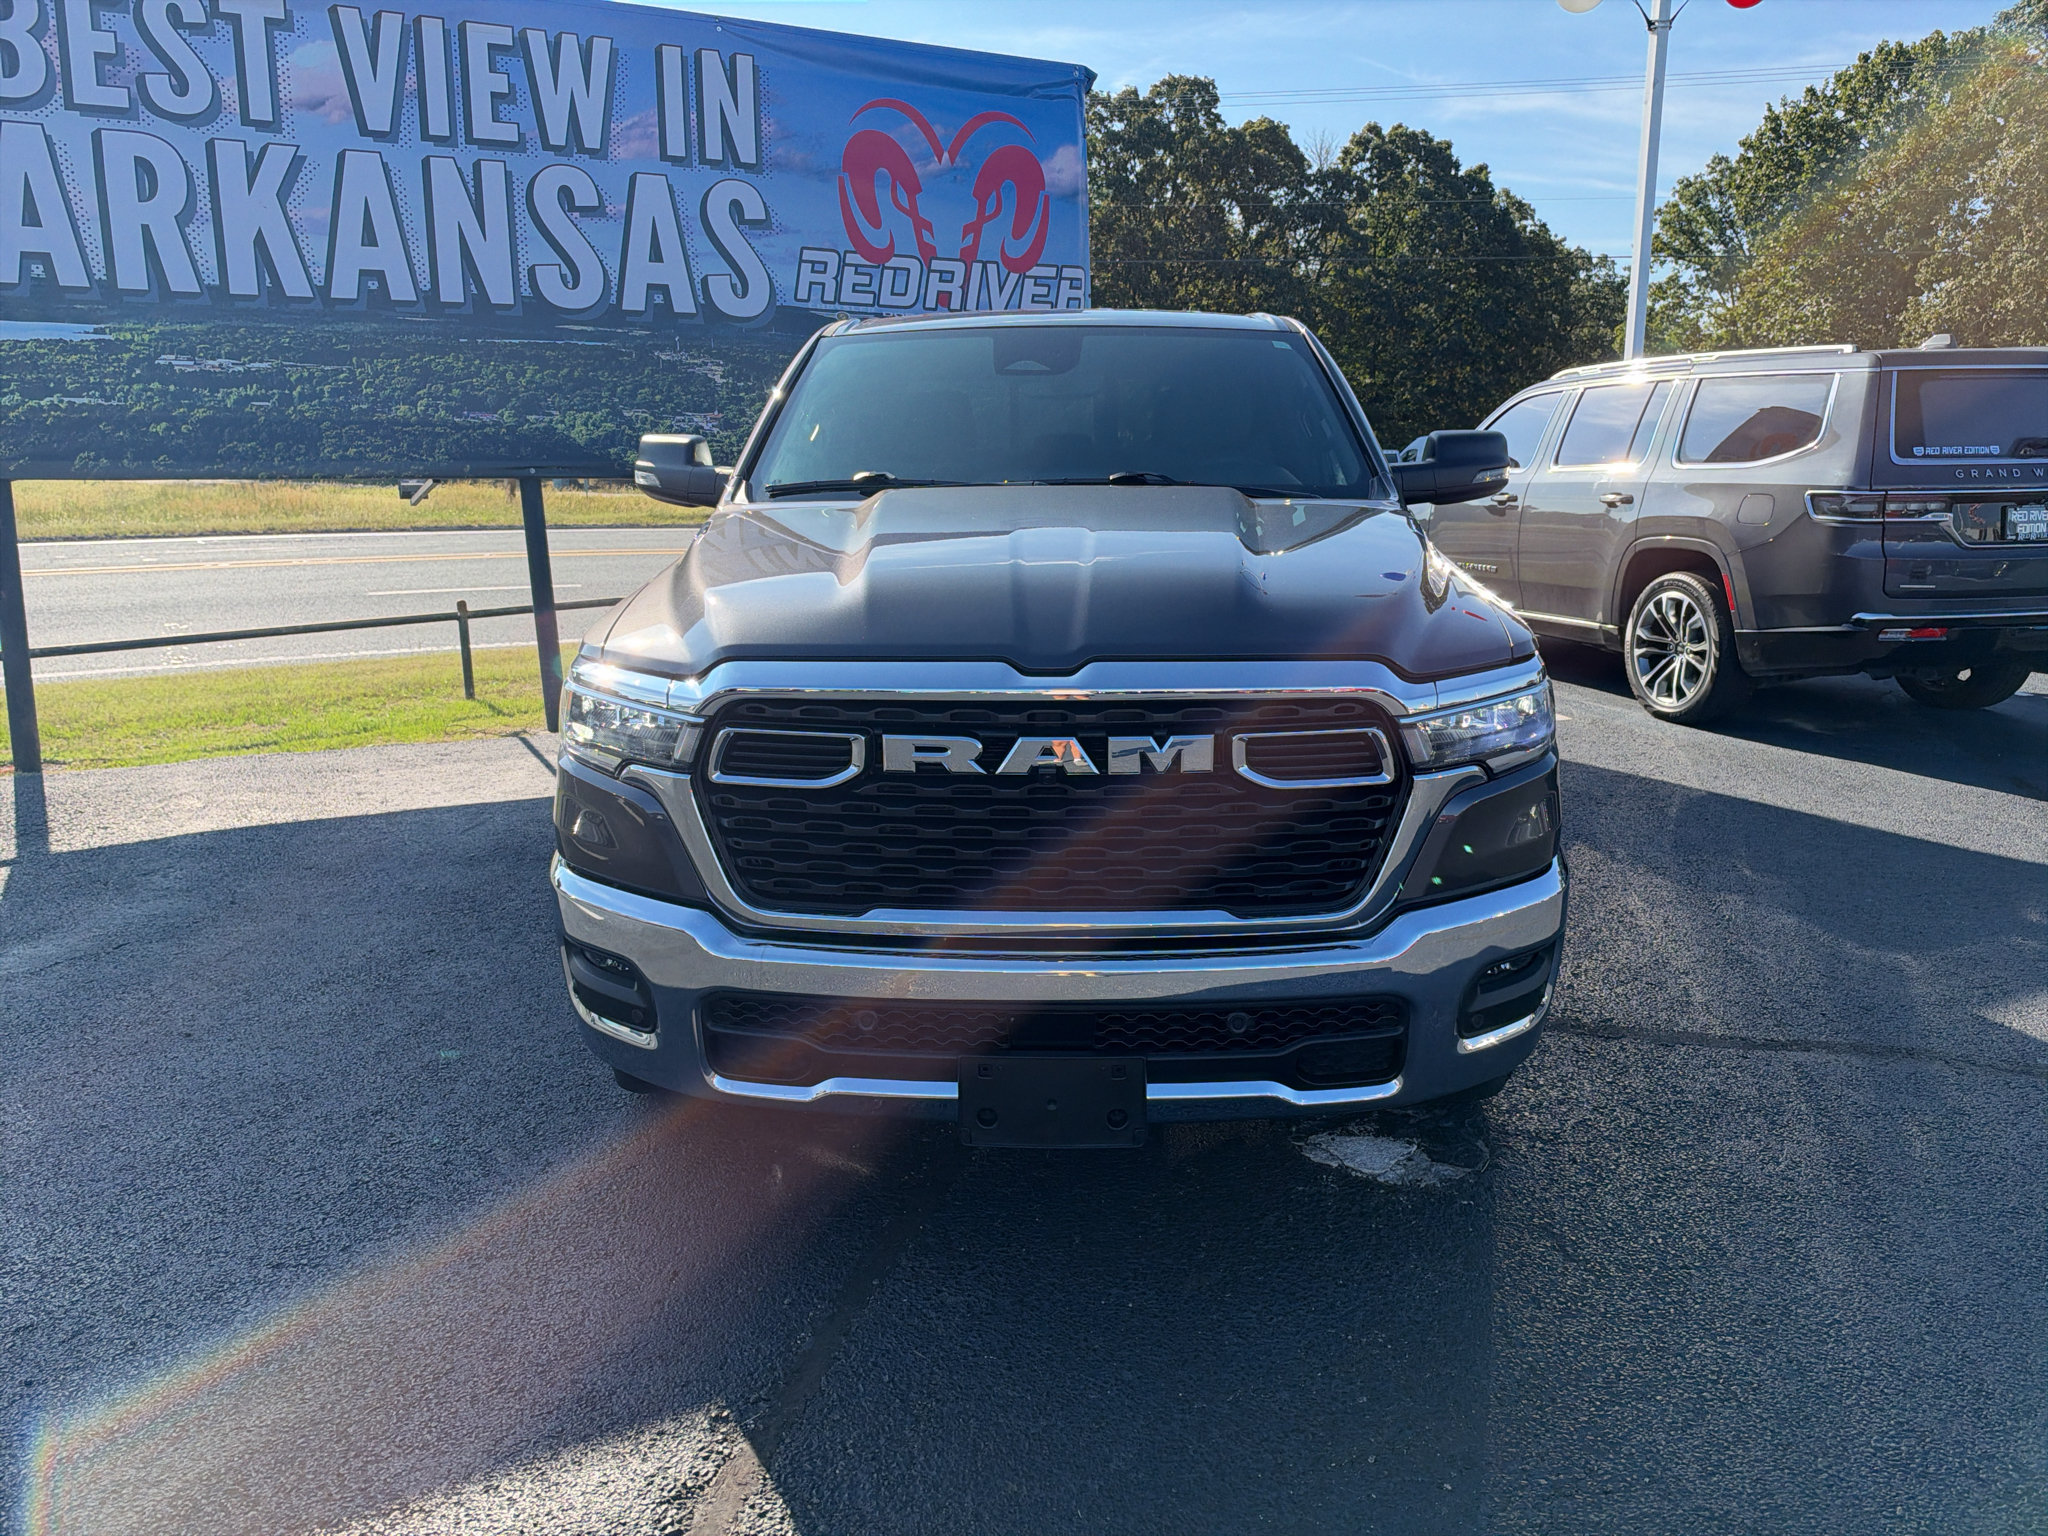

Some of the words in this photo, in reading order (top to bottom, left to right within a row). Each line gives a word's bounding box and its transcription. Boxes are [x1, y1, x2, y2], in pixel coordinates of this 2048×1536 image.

[0, 0, 287, 123] BEST
[328, 4, 613, 152] VIEW
[656, 43, 755, 166] IN
[0, 119, 772, 318] ARKANSAS
[1925, 446, 1940, 455] RED
[1942, 446, 1962, 455] RIVER
[1964, 445, 1990, 455] EDITION
[1955, 468, 2021, 478] GRAND
[2011, 510, 2028, 521] RED
[2017, 523, 2047, 534] EDITION
[882, 734, 1215, 776] RAM
